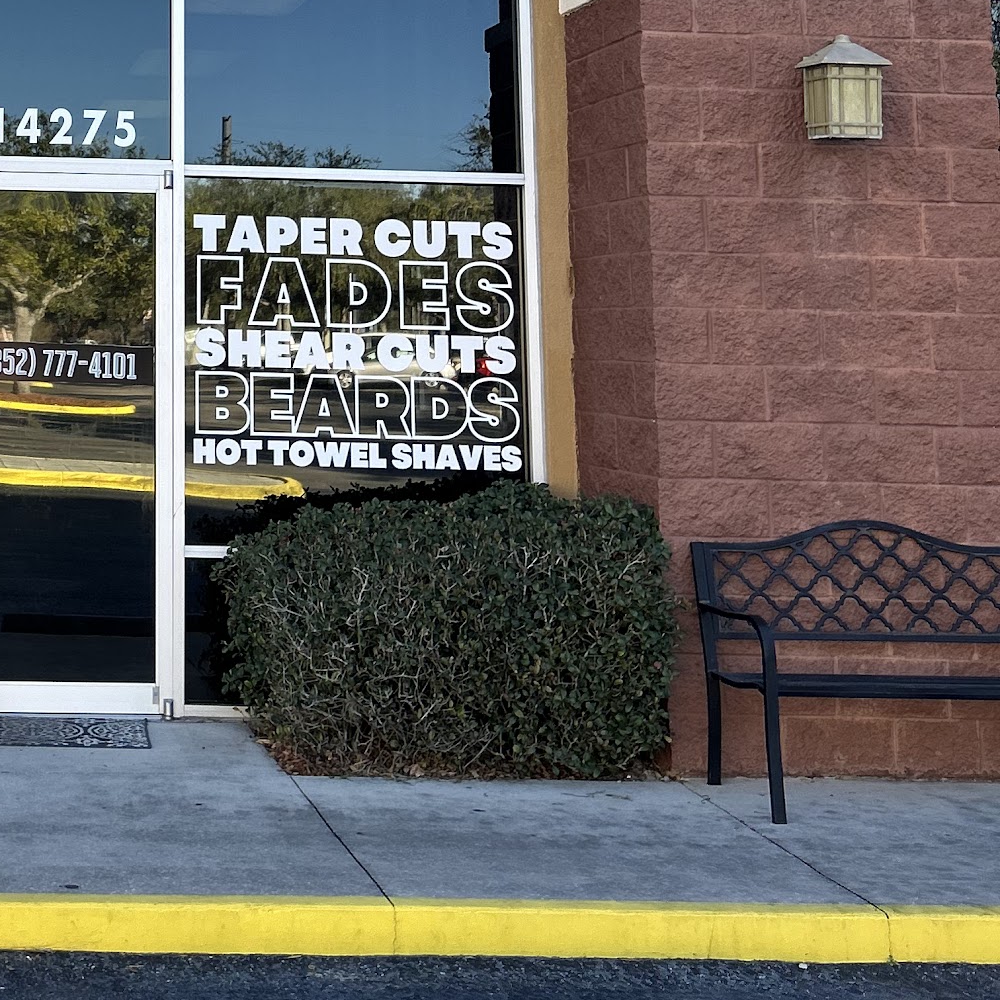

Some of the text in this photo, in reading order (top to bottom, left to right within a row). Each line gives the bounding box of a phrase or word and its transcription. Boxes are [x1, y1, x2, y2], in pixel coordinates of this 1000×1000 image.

[193, 214, 514, 260] TAPER CUTS
[196, 254, 515, 333] FADES
[43, 350, 137, 380] 777-4101
[195, 327, 517, 374] SHEAR CUTS
[194, 370, 521, 443] BEARDS
[193, 438, 523, 472] HOT TOWEL SHAVES
